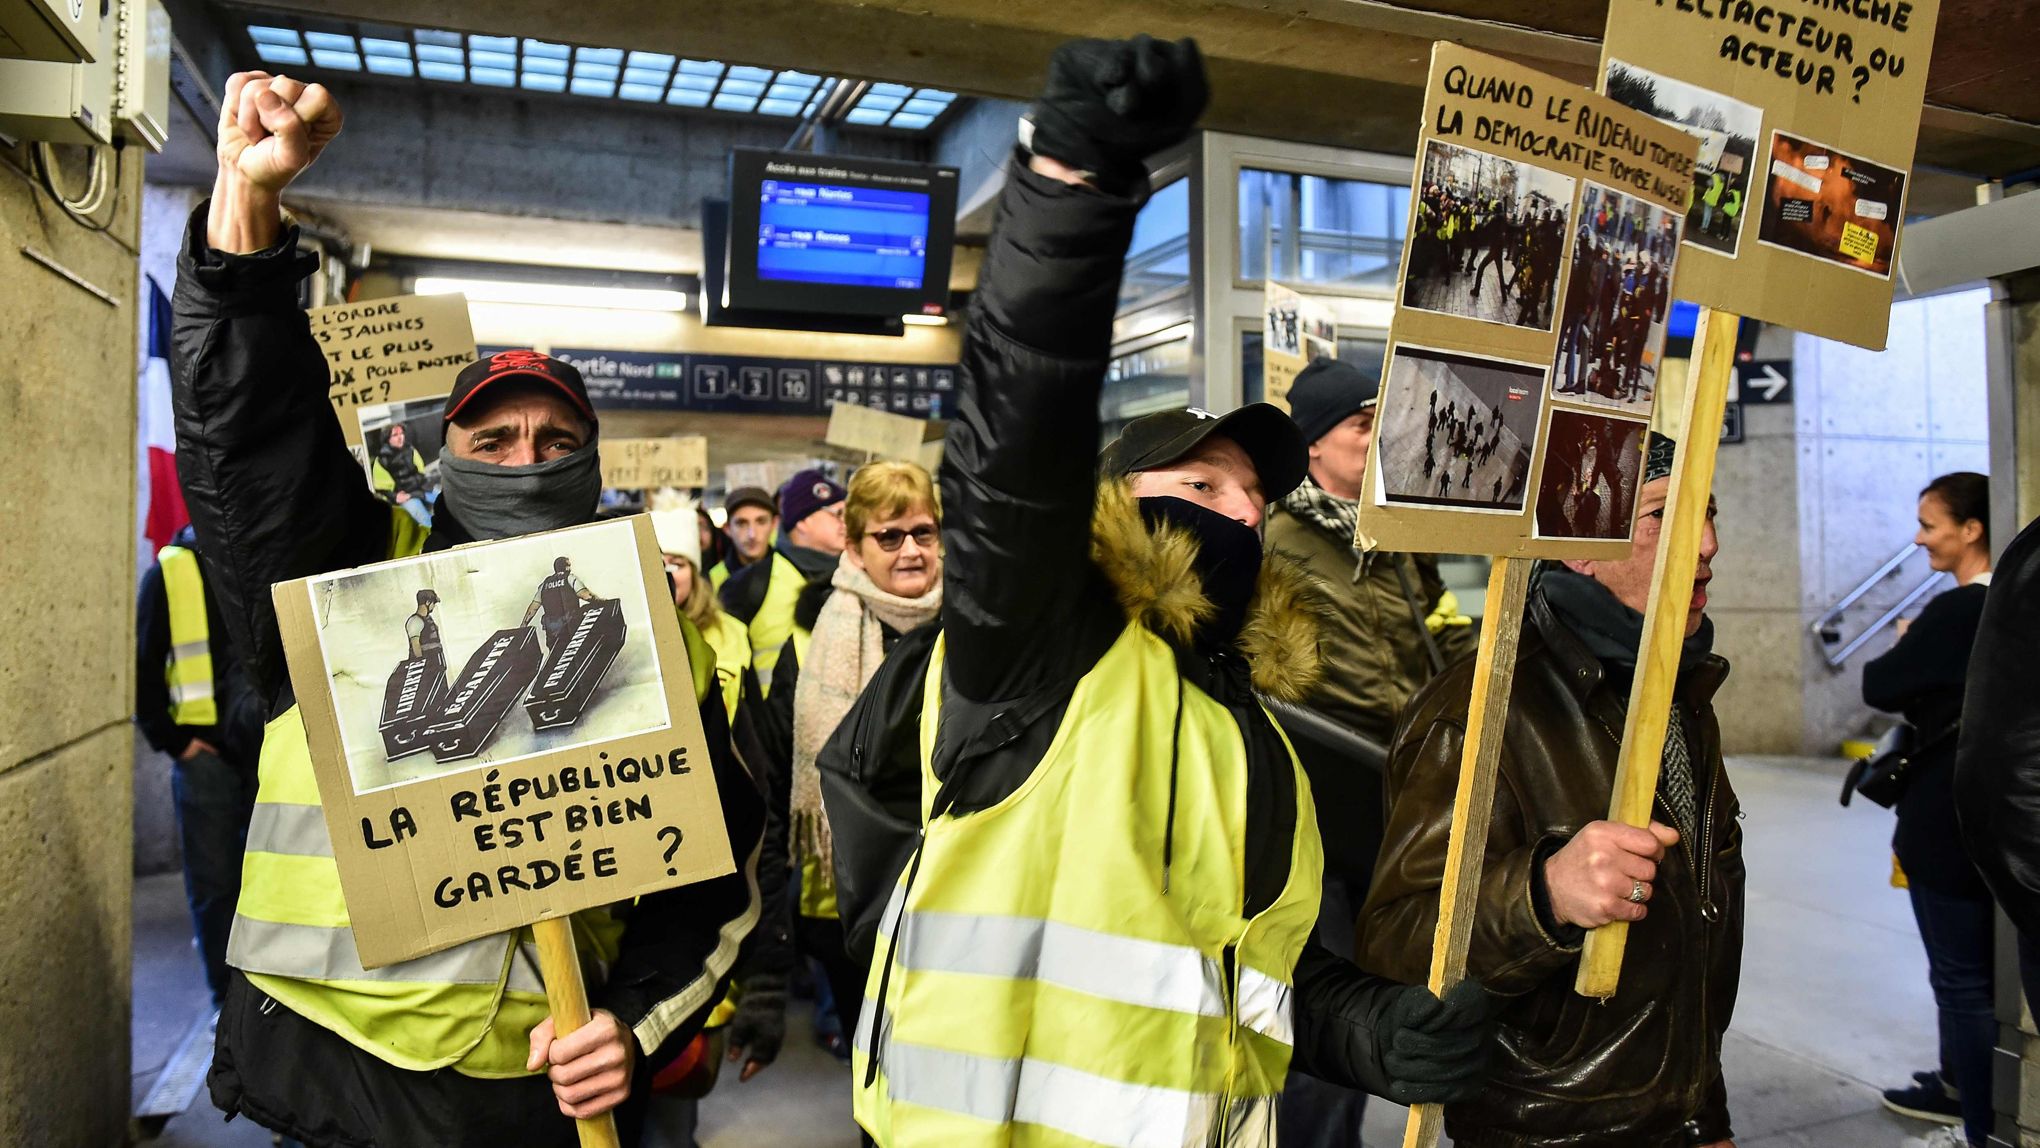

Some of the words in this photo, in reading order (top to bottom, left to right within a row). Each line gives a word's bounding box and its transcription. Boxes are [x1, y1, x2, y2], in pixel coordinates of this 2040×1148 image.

[1719, 34, 1835, 95] ACTEUR
[1852, 66, 1870, 104] ?
[1869, 48, 1904, 77] OU
[1437, 104, 1463, 136] LA
[1474, 115, 1606, 172] DEMOCRATIE
[1608, 157, 1652, 190] TOMBE
[1444, 65, 1533, 109] QUAND
[1545, 96, 1573, 123] LE
[1575, 105, 1647, 157] RIDEAU
[1649, 142, 1693, 177] TOMBE
[323, 303, 401, 326] L'ORDRE
[340, 317, 425, 340] JAUNES
[352, 347, 374, 361] LE
[383, 339, 433, 356] PLUS
[366, 361, 413, 380] POUR
[418, 351, 475, 371] NOTRE
[784, 380, 805, 398] 10
[445, 635, 515, 716] ÉGALITÉ
[544, 606, 605, 688] FRATERNITÉ
[396, 658, 427, 715] LIBERTÉ
[361, 808, 417, 850] LA
[450, 746, 692, 823] RÉPUBLIQUE
[474, 811, 554, 852] EST
[433, 840, 618, 909] GARDÉE
[657, 826, 684, 877] ?
